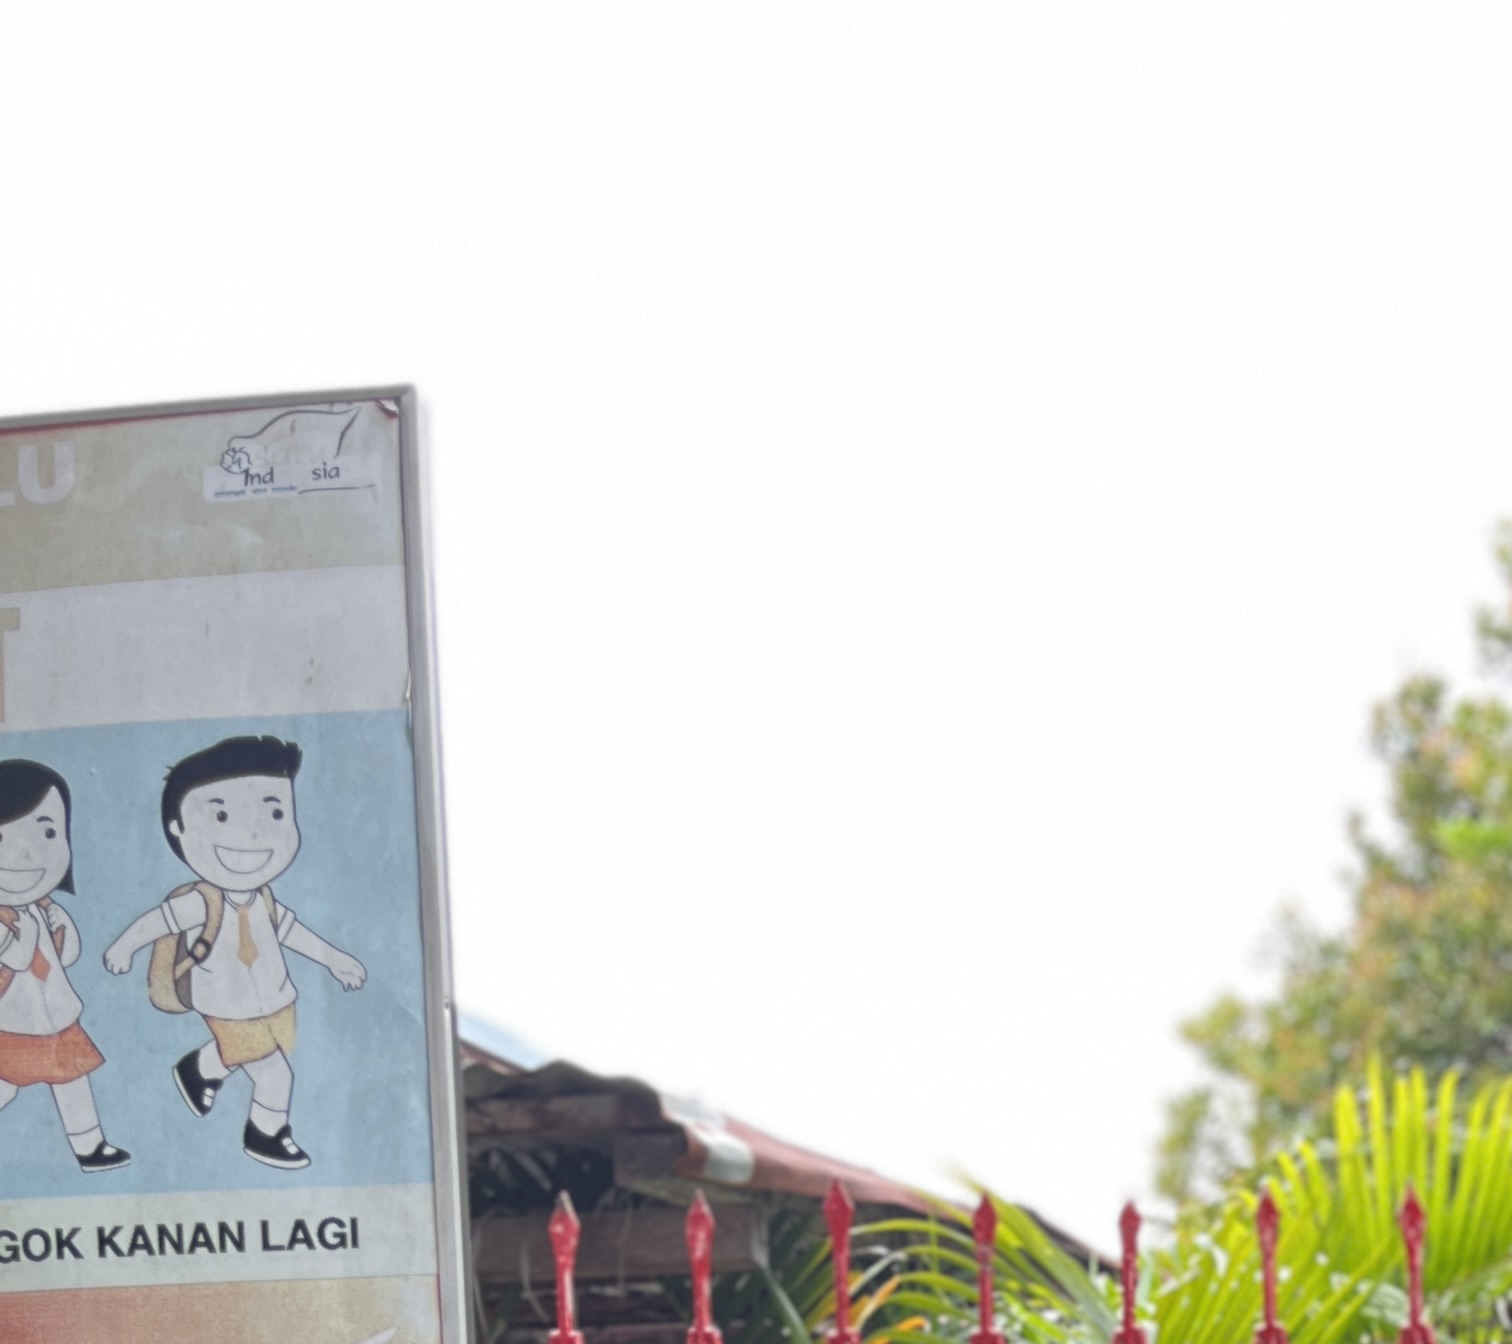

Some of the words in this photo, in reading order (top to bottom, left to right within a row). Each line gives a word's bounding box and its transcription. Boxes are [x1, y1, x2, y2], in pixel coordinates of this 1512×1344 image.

[311, 461, 341, 481] sia
[96, 1220, 247, 1258] KANAN
[260, 1217, 360, 1252] LAGI
